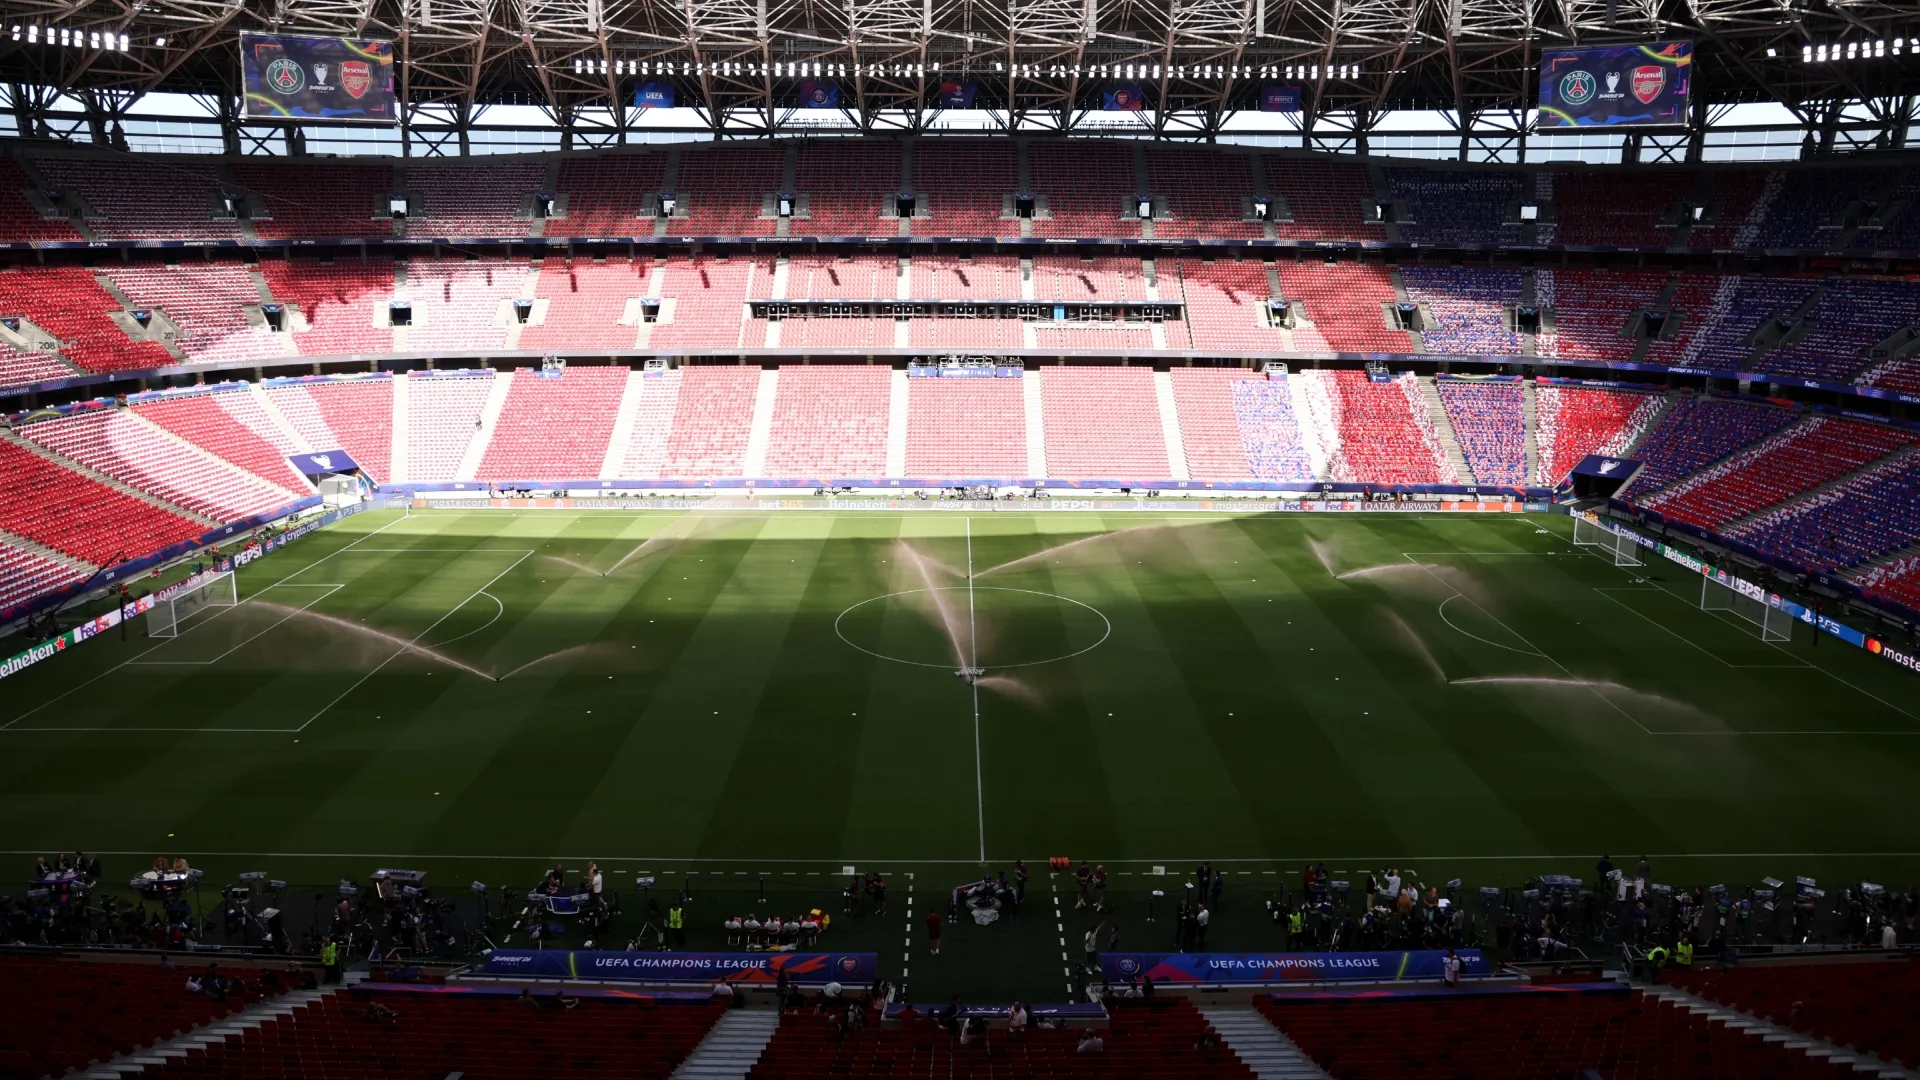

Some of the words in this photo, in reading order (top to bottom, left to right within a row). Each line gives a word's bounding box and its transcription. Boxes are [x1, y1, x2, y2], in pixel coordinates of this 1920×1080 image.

[272, 60, 298, 70] PARIS
[343, 66, 369, 74] Arsenal
[1566, 72, 1590, 81] PARIS
[1635, 71, 1661, 79] Arsenal
[39, 342, 56, 350] 208
[11, 387, 30, 395] LEAGUE
[343, 503, 362, 517] PS5
[759, 501, 804, 509] bet365
[828, 501, 887, 509] Heineken
[1051, 500, 1094, 510] PEPSI
[1284, 501, 1315, 511] FedEx
[1325, 502, 1356, 511] FedEx
[1365, 502, 1396, 510] QATAR
[1398, 502, 1438, 510] AIRWAYS
[287, 520, 320, 543] crypto.com
[1620, 527, 1653, 549] crypto.com
[234, 545, 263, 568] PEPSI
[1664, 545, 1702, 573] Heineken
[1820, 576, 1829, 585] 130
[80, 617, 110, 640] FedEx
[0, 643, 55, 679] eineken
[1883, 646, 1920, 672] maste
[595, 958, 630, 967] UEFA
[633, 958, 711, 968] CHAMPIONS
[715, 959, 767, 969] LEAGUE
[1210, 959, 1245, 969] UEFA
[1247, 959, 1325, 968] CHAMPIONS
[1329, 958, 1380, 967] LEAGUE
